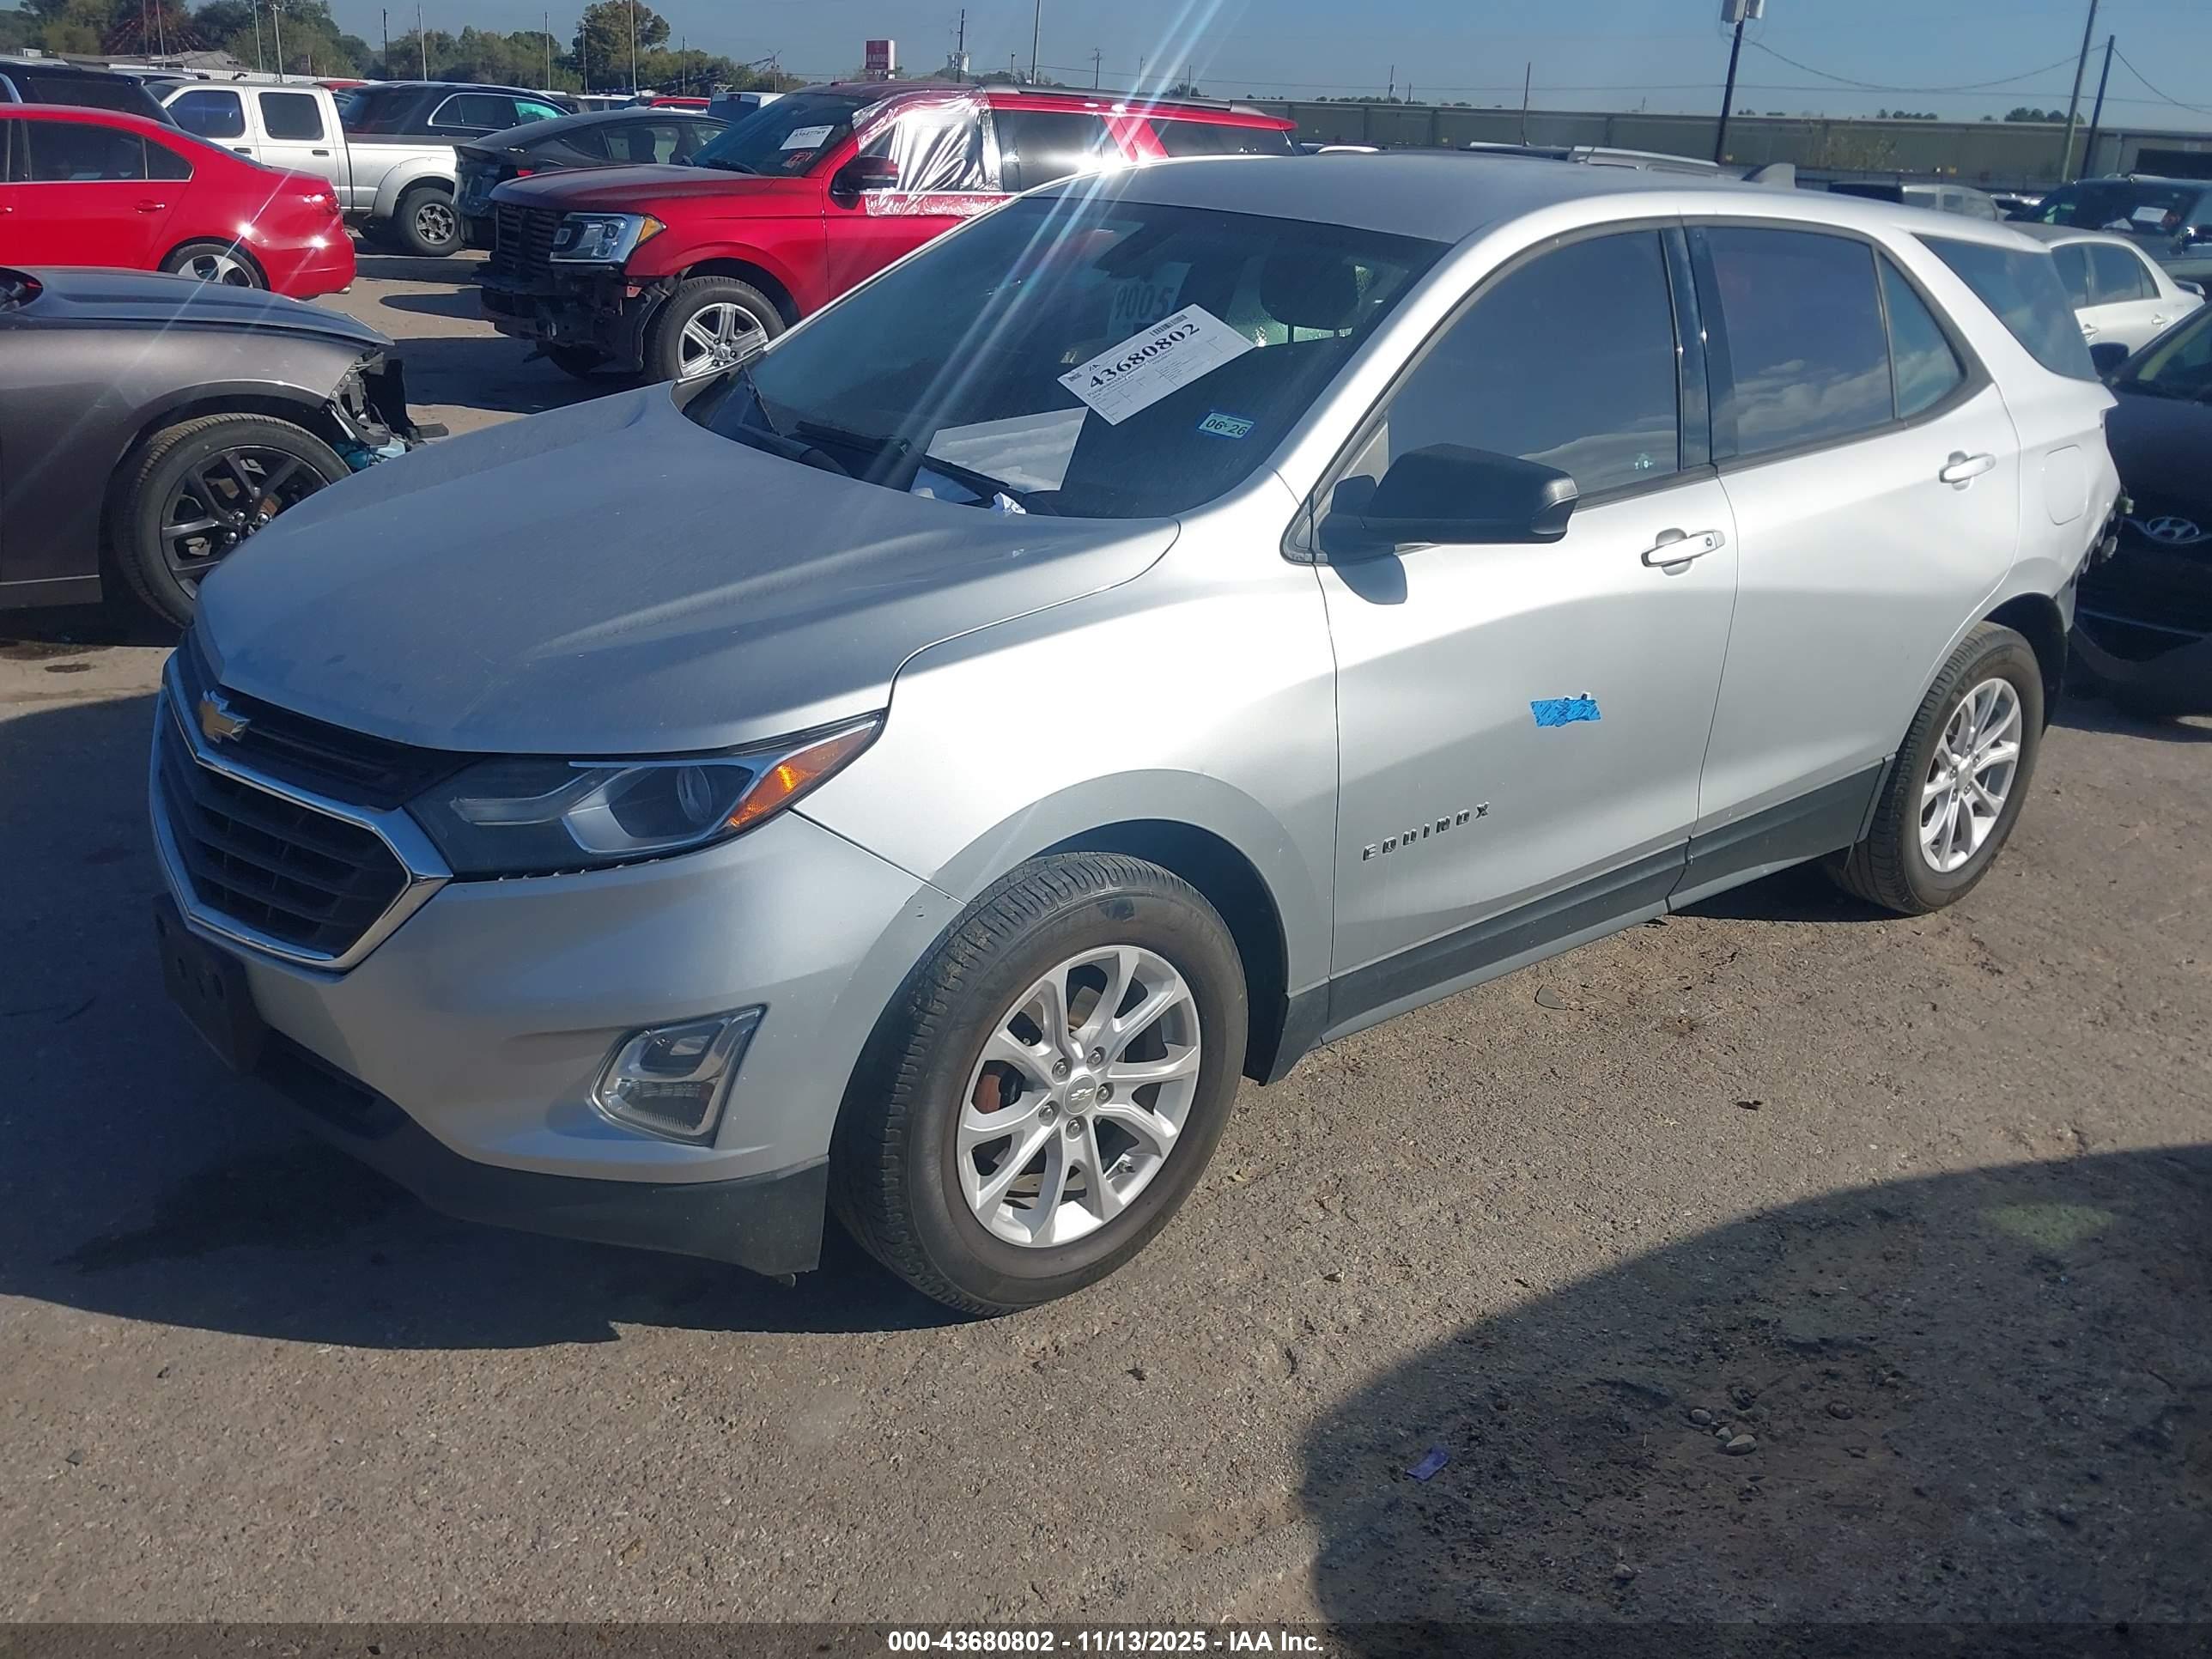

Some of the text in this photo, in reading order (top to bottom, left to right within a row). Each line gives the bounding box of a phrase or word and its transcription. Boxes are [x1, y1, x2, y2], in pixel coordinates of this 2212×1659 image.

[1090, 323, 1200, 389] 43680802
[1206, 419, 1248, 435] 06 26
[1362, 801, 1490, 861] EQUINOX
